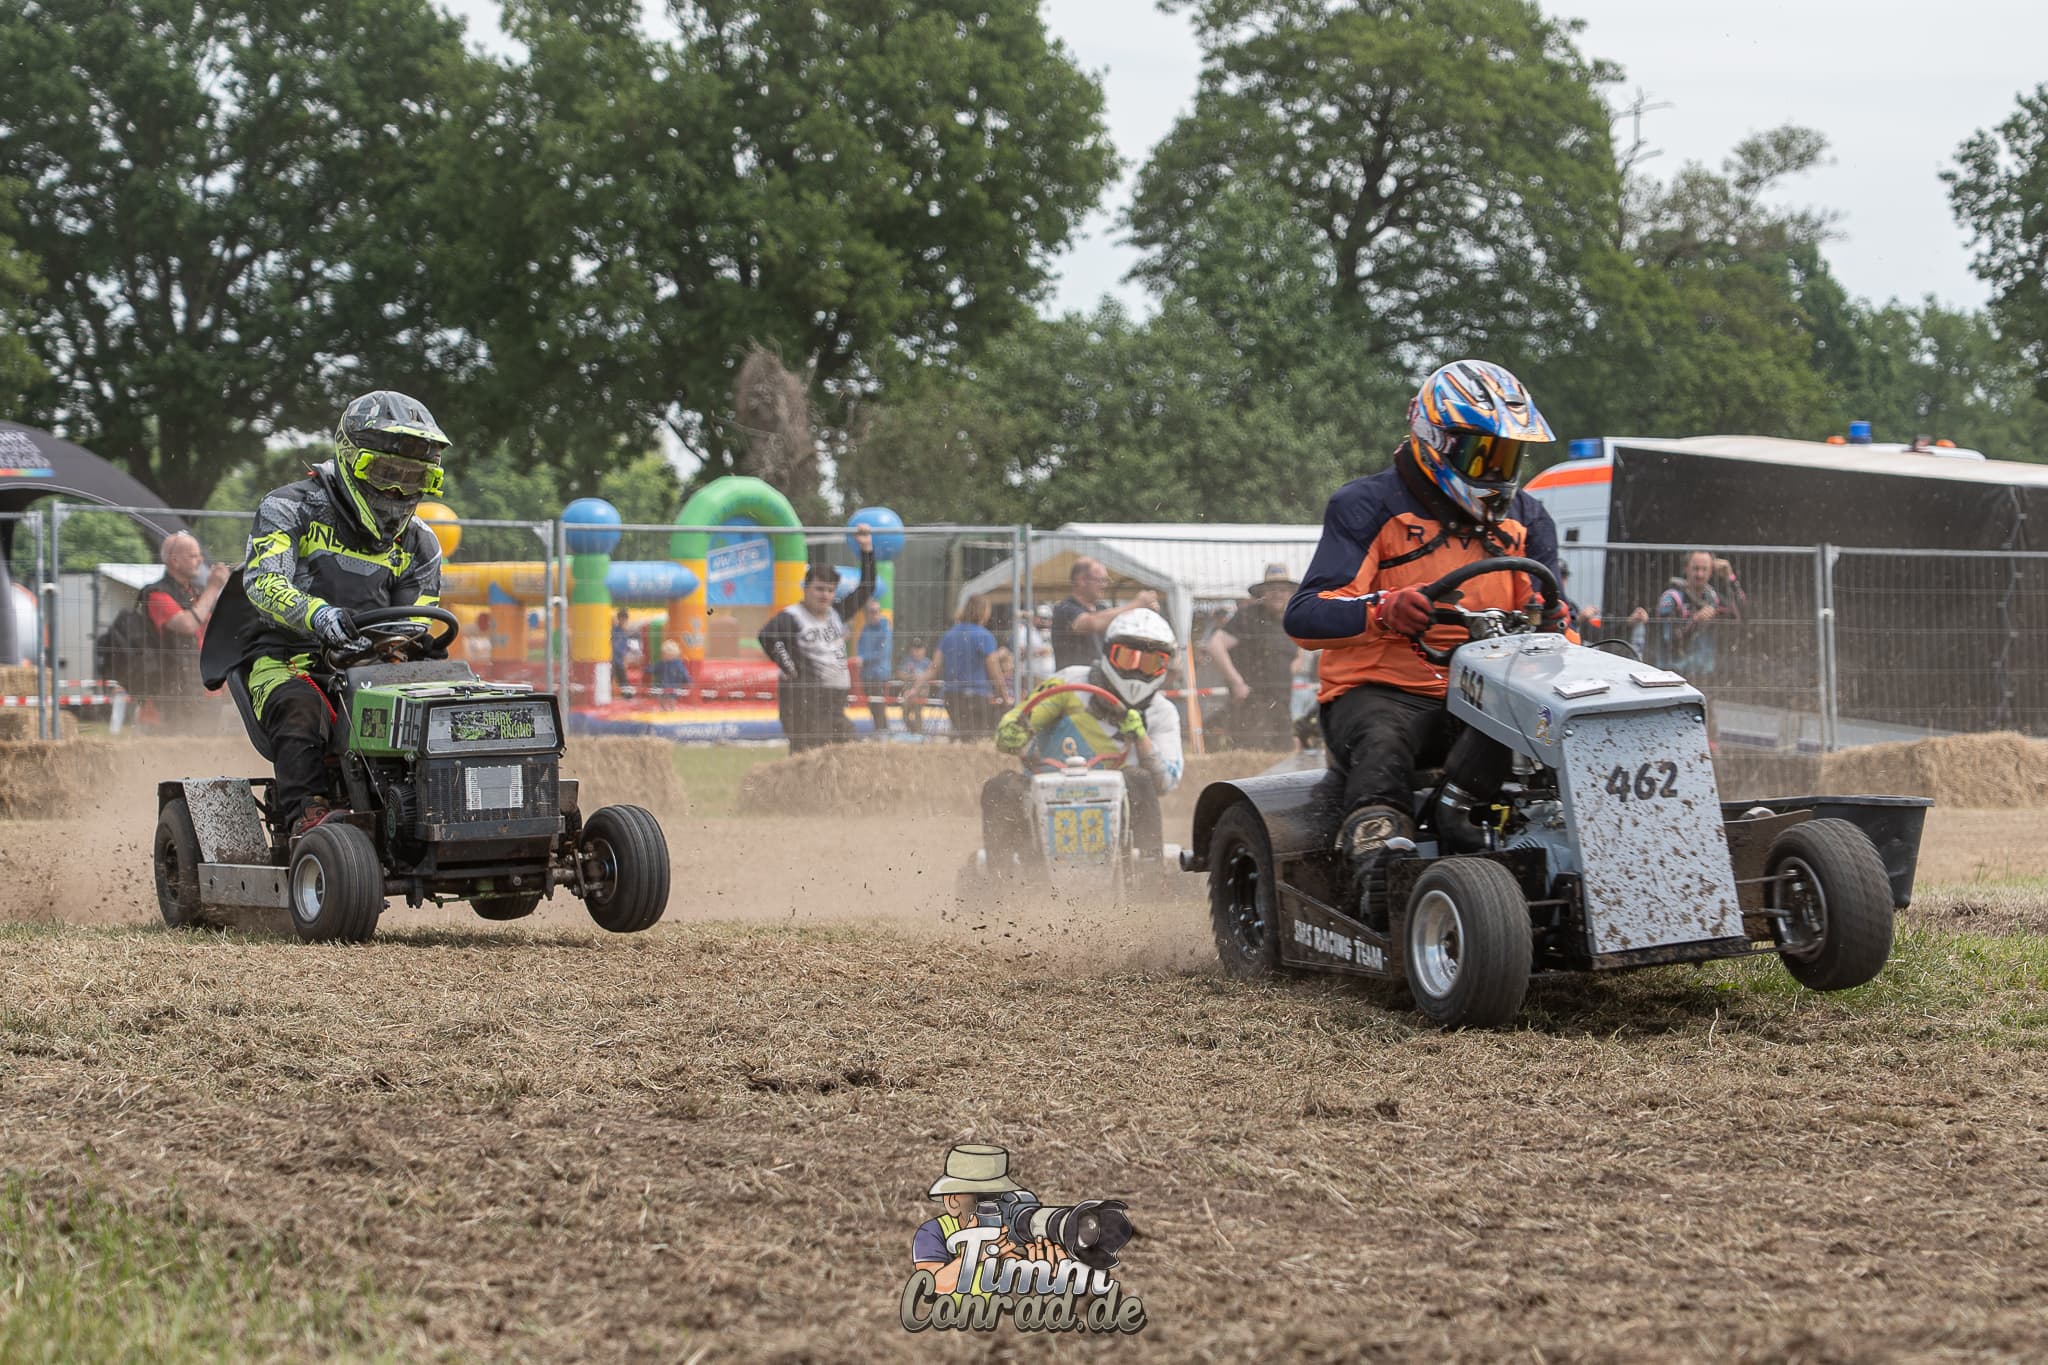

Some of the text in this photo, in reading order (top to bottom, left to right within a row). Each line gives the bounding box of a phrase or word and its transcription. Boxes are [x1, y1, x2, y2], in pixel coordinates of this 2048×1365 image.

[1406, 524, 1521, 551] RVEN
[482, 711, 513, 727] SHARK
[500, 722, 532, 739] RACING
[1605, 761, 1678, 802] 462
[1053, 808, 1105, 854] 88
